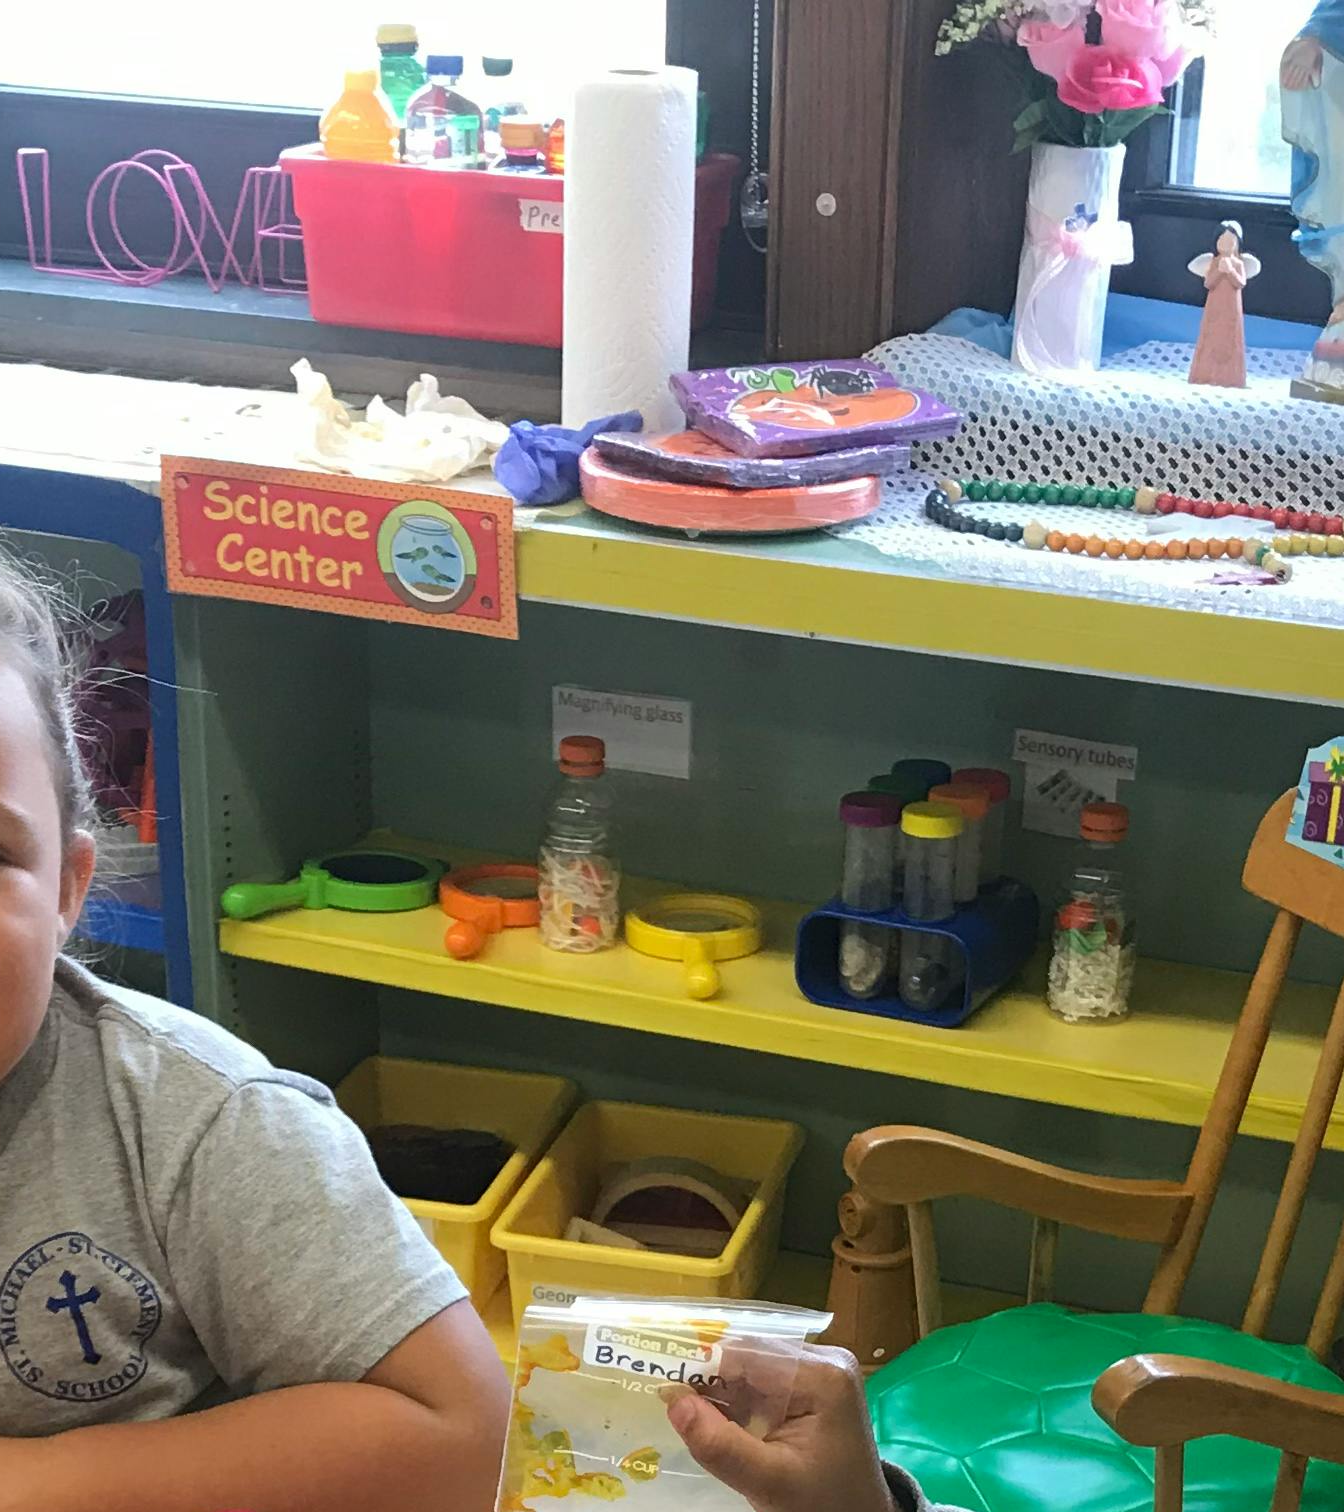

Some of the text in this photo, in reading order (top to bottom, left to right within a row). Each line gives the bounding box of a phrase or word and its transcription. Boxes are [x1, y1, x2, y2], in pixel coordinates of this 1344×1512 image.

[203, 480, 370, 540] Science
[215, 533, 363, 590] Center
[558, 690, 684, 724] Magnifying glass
[1018, 735, 1136, 770] Sensory tubes
[0, 1246, 55, 1347] MICHAEL
[599, 1327, 707, 1362] Portion Pack
[594, 1344, 729, 1391] Brendan
[632, 1460, 661, 1475] CUP
